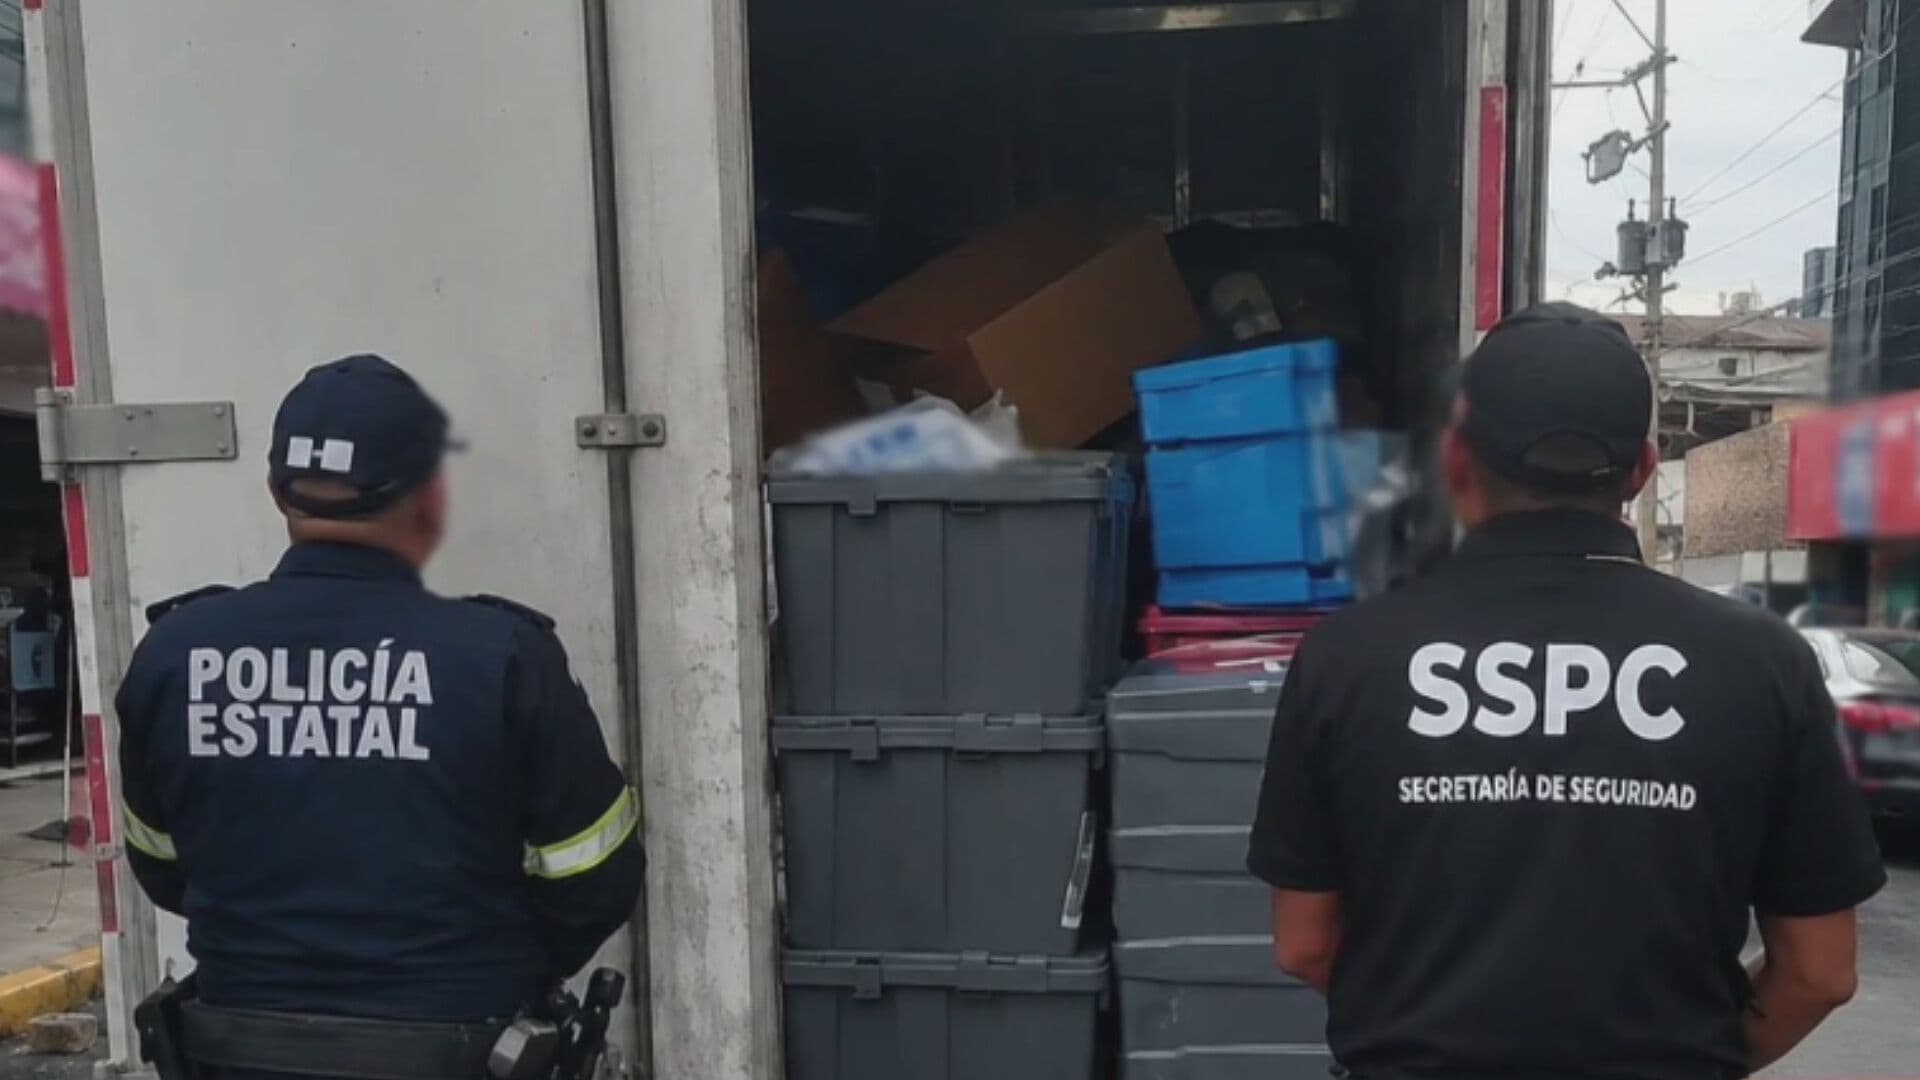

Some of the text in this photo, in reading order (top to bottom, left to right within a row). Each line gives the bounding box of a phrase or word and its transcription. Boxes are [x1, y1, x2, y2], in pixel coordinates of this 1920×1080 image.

[188, 638, 433, 704] POLICÍA
[1407, 641, 1689, 740] SSPC
[188, 703, 430, 760] ESTATAL
[1398, 767, 1697, 810] SECRETARÍA DE SEGURIDAD
